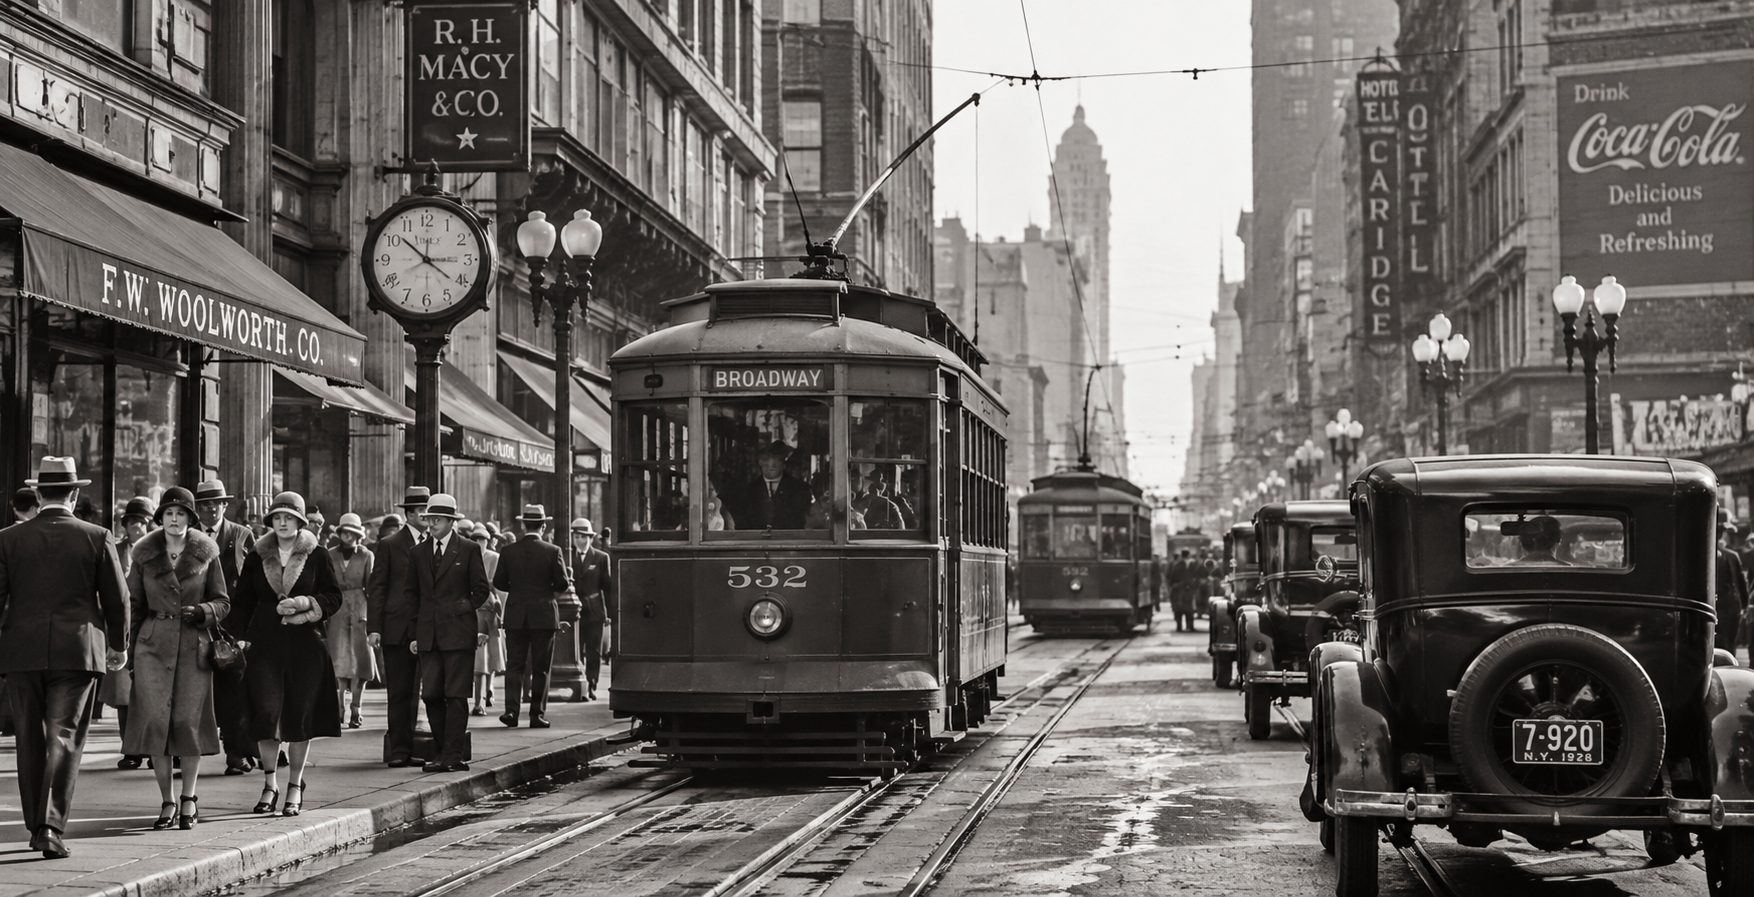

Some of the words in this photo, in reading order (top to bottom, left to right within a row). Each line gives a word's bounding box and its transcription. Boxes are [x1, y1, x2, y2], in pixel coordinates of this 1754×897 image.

[434, 19, 462, 44] R.
[471, 18, 501, 44] H.
[418, 53, 515, 80] MACY
[1574, 82, 1631, 103] Drink
[1608, 182, 1703, 206] Delicious
[420, 213, 434, 228] 12
[1636, 206, 1672, 227] and
[386, 234, 401, 247] 10
[457, 233, 466, 246] 2
[1369, 140, 1391, 335] CARIDGE
[1599, 229, 1714, 255] Refreshing
[380, 253, 391, 267] 9
[463, 253, 473, 266] 3
[402, 288, 412, 302] 7
[421, 294, 432, 307] 6
[442, 288, 452, 302] 5
[297, 327, 324, 366] CO.
[715, 369, 822, 388] BROADWAY
[727, 565, 807, 588] 532
[1522, 723, 1594, 752] 7-920
[1524, 752, 1554, 761] N.Y.
[1562, 752, 1593, 762] 1928
